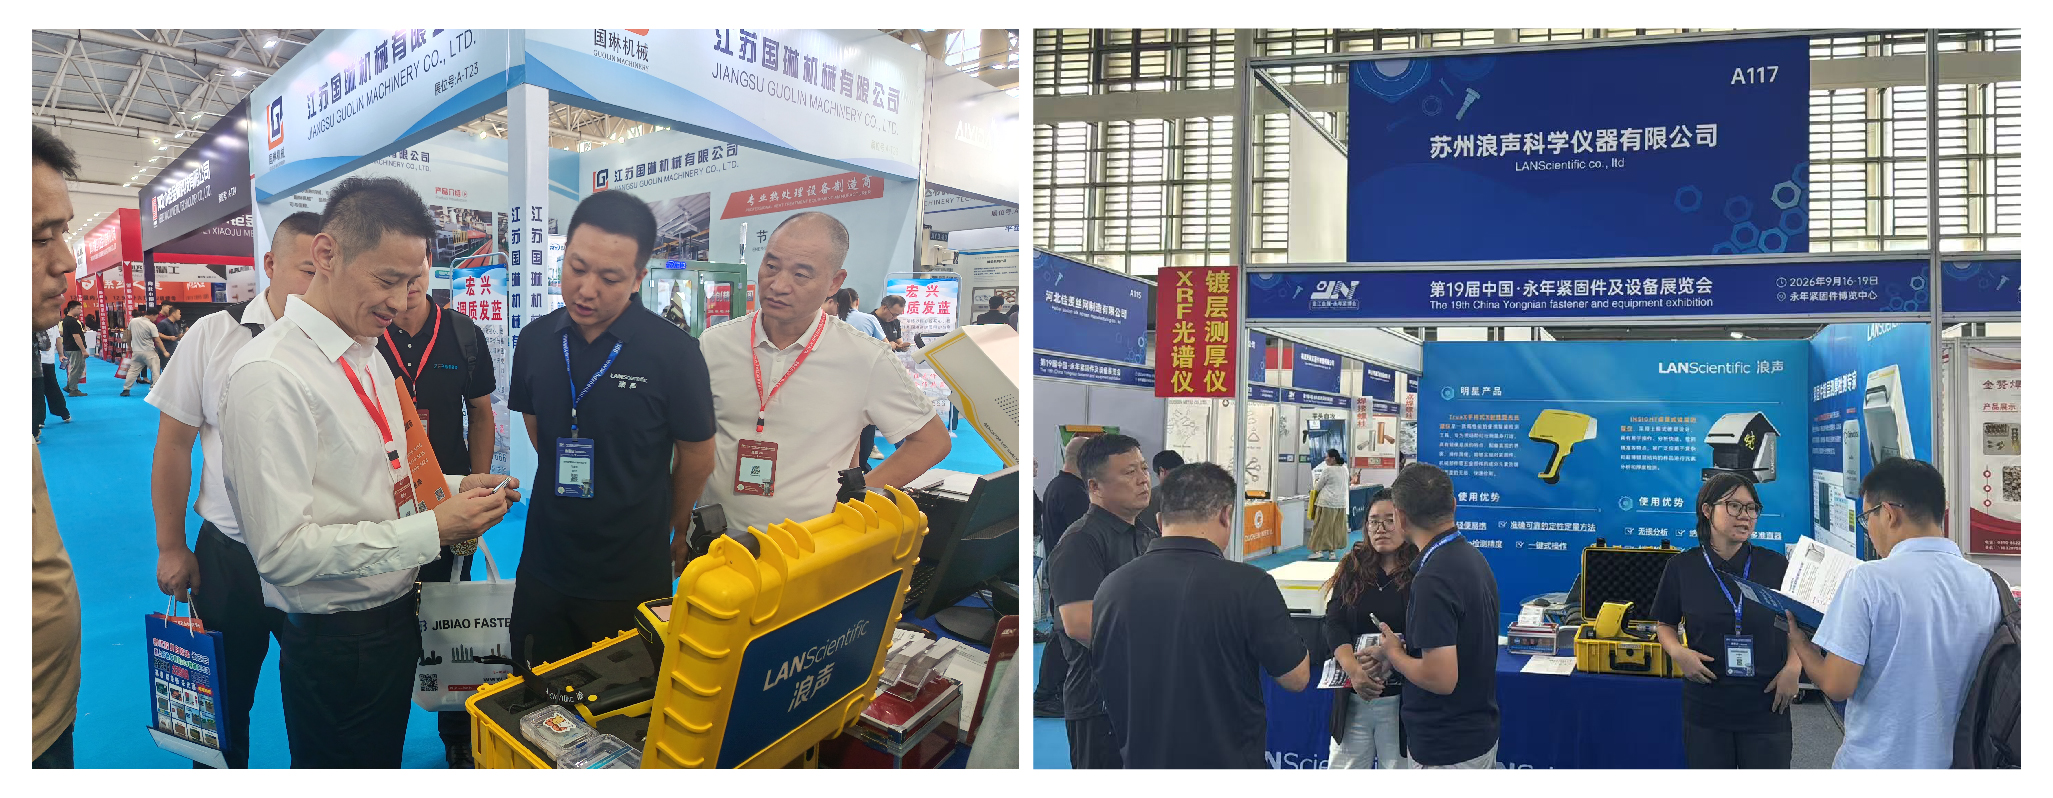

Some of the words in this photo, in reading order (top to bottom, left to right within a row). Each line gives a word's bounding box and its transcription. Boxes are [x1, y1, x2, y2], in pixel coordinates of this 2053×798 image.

[594, 29, 649, 62] 国琳机械
[306, 29, 444, 119] 江苏国琳机械有限
[367, 60, 419, 107] MACHINERY
[449, 29, 476, 57] LTD.
[713, 29, 900, 114] 江苏国琳机械有限公司
[1730, 66, 1779, 85] A117
[712, 63, 764, 92] JIANGSU
[768, 80, 807, 106] GUOLIN
[809, 94, 862, 122] MACHINERY
[1430, 123, 1718, 159] 苏州浪声科学仪器有限公司
[614, 144, 738, 182] 江苏国琳机械有限公司
[1515, 158, 1586, 172] LANScientific
[1612, 157, 1625, 169] ltd
[747, 175, 872, 206] 专业热处理设备制造商
[212, 228, 241, 237] XIAOJU
[756, 230, 768, 243] 节
[465, 275, 491, 296] 宏兴
[905, 284, 940, 298] 宏兴
[1430, 277, 1713, 298] 第19届中国·永年紧固件及设备展览会
[1789, 276, 1879, 287] 2026年9月16-19日
[1430, 301, 1447, 309] The
[1451, 300, 1470, 309] 19th
[1473, 300, 1500, 309] China
[1503, 299, 1547, 311] Yongnian
[1550, 298, 1589, 309] fastener
[1591, 299, 1609, 308] and
[1611, 298, 1663, 310] equipment
[1666, 297, 1713, 307] exhibition
[1789, 291, 1878, 301] 永年紧固件博览中心
[903, 301, 951, 315] 质发蓝
[1171, 270, 1195, 393] XRF光谱仪
[1203, 269, 1231, 393] 镀层测厚仪
[1658, 361, 1751, 375] LANScientific
[1756, 360, 1784, 374] 浪声
[1460, 386, 1502, 396] 明星产品
[1458, 492, 1500, 503] 使用优势
[1638, 496, 1684, 508] 使用优势
[432, 618, 470, 631] JIBIAO
[763, 619, 870, 692] LANScientific
[787, 661, 836, 714] 浪声
